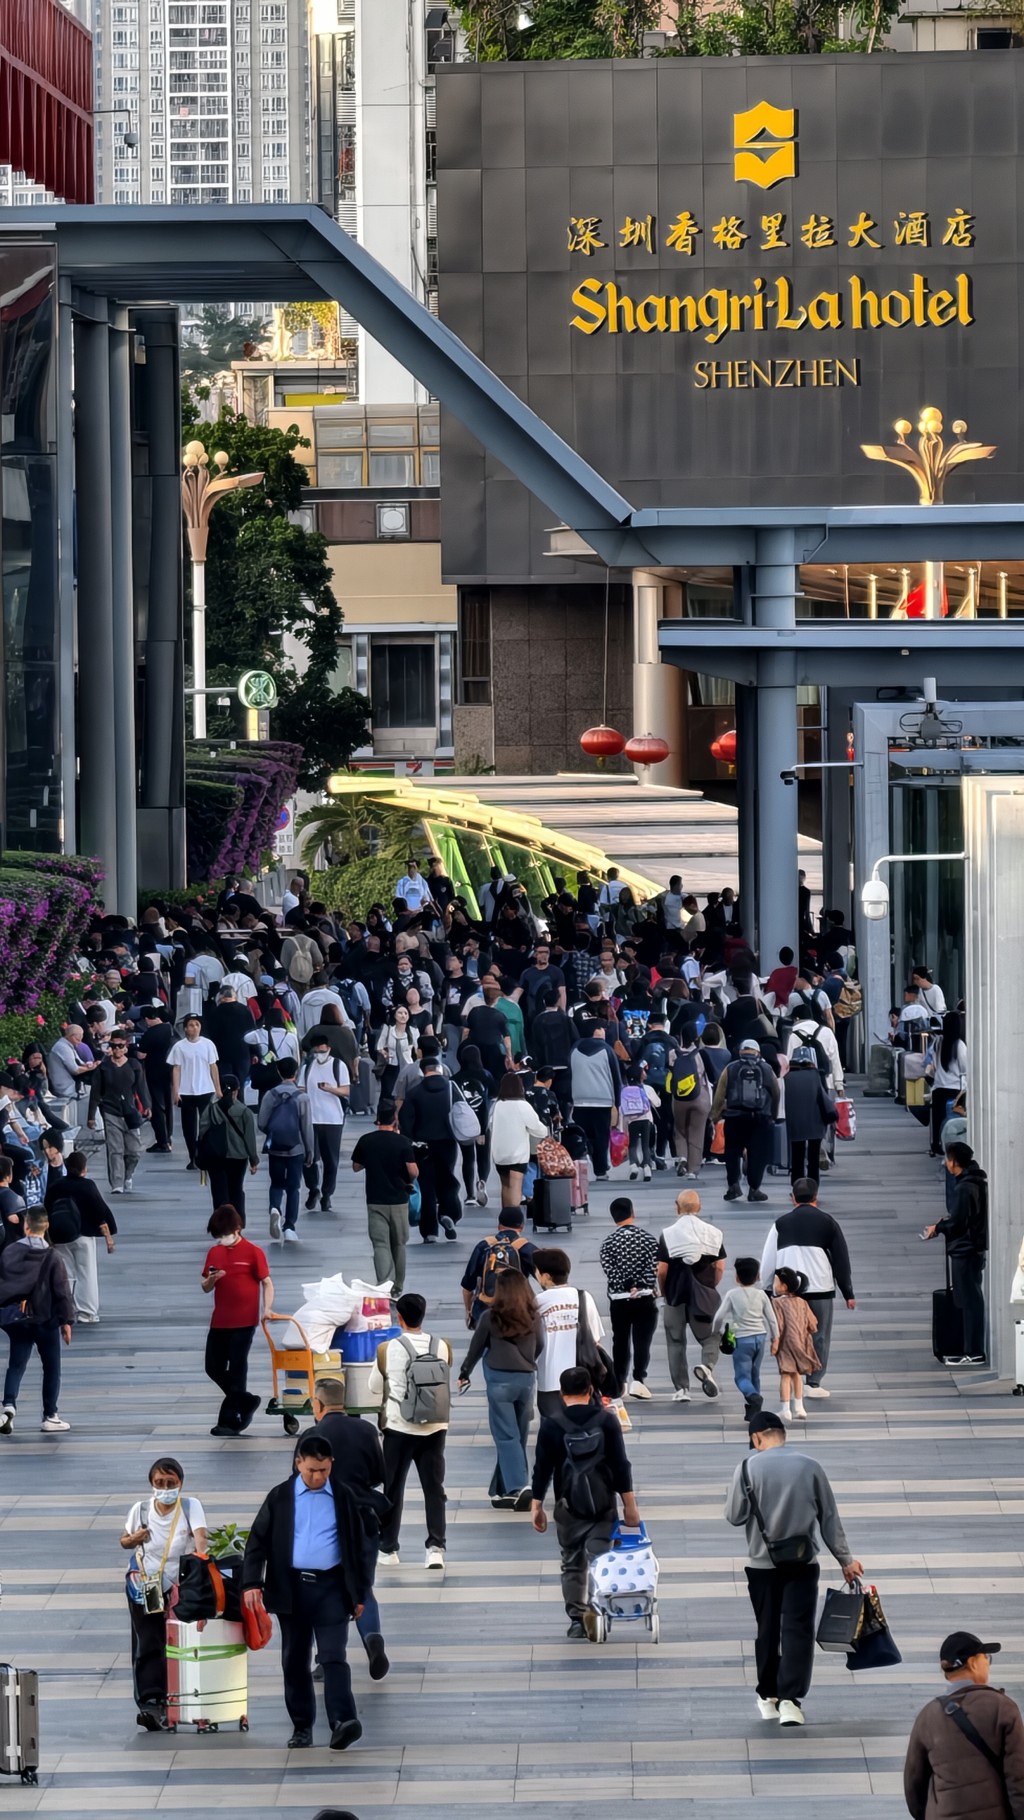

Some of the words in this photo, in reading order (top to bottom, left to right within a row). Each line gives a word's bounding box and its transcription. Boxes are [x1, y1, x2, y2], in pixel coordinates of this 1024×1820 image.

[567, 208, 974, 255] 深圳香格里拉大酒店
[848, 272, 974, 329] hotel
[693, 358, 860, 388] SHENZHEN
